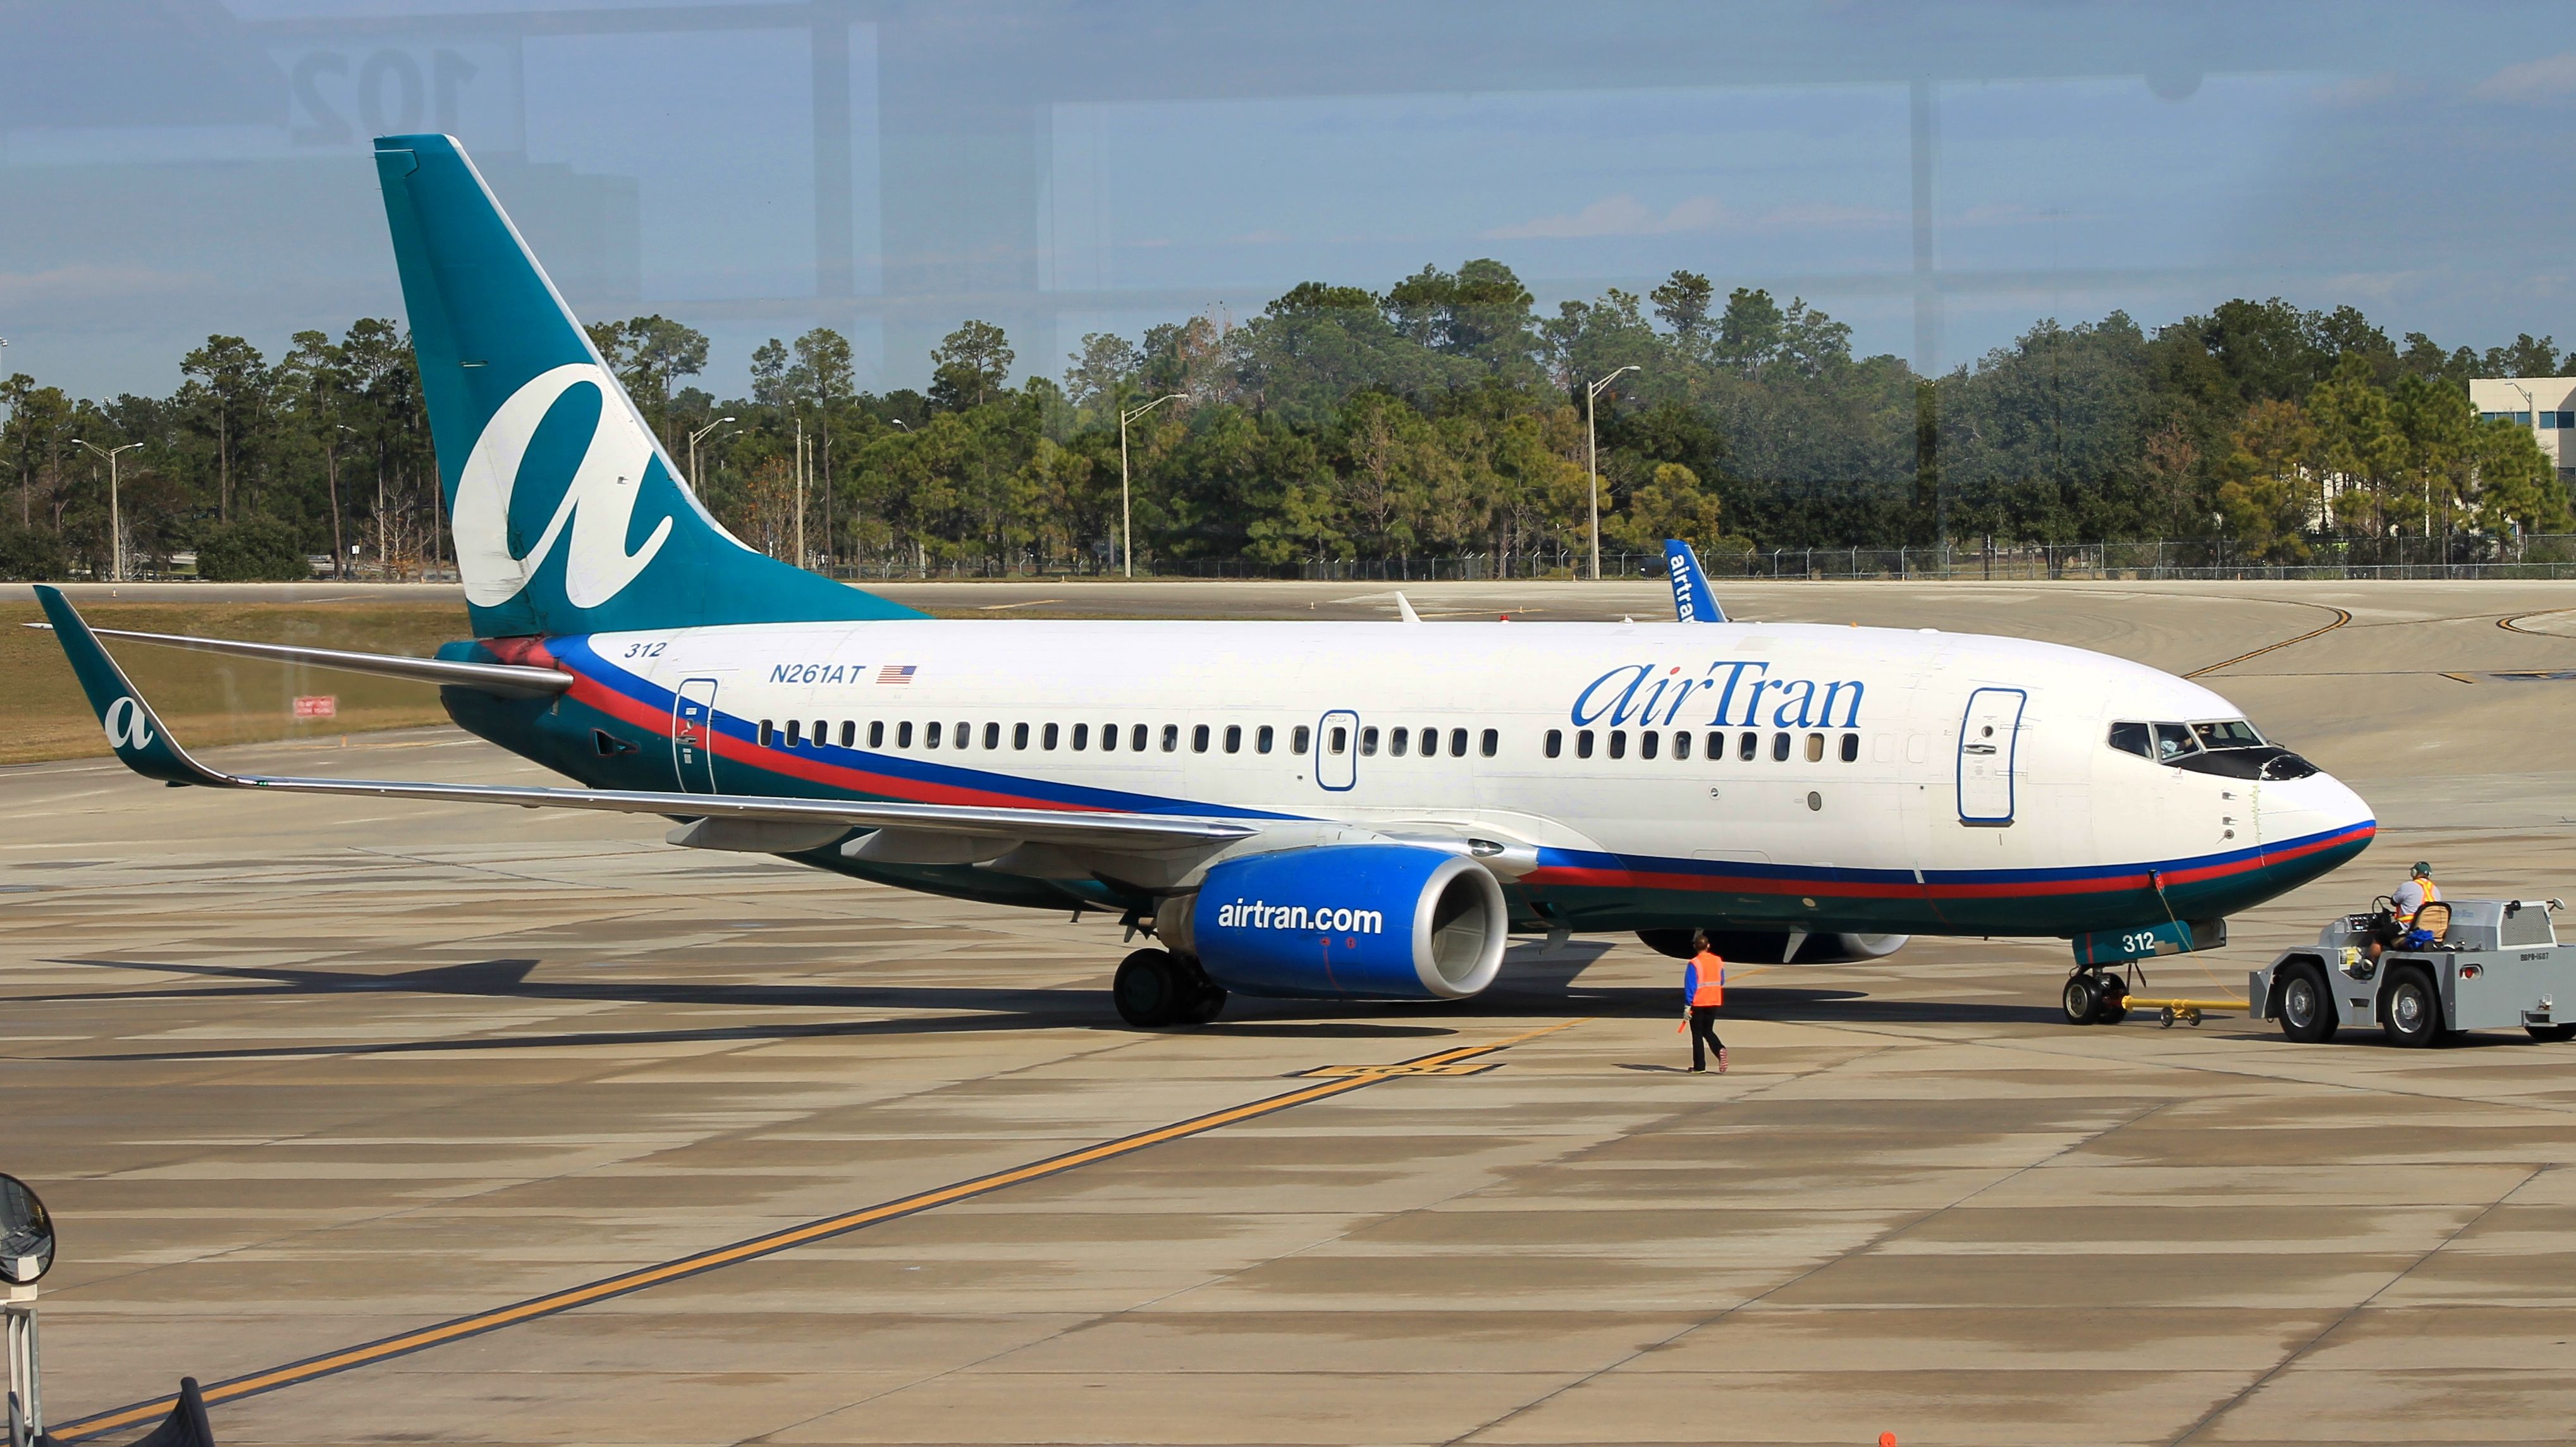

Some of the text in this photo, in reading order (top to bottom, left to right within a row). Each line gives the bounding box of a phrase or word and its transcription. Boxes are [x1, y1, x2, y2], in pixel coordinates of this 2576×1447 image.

[624, 642, 667, 658] 312
[770, 664, 866, 685] N261AT
[1218, 898, 1383, 934] airtran.com
[2122, 932, 2154, 953] 312
